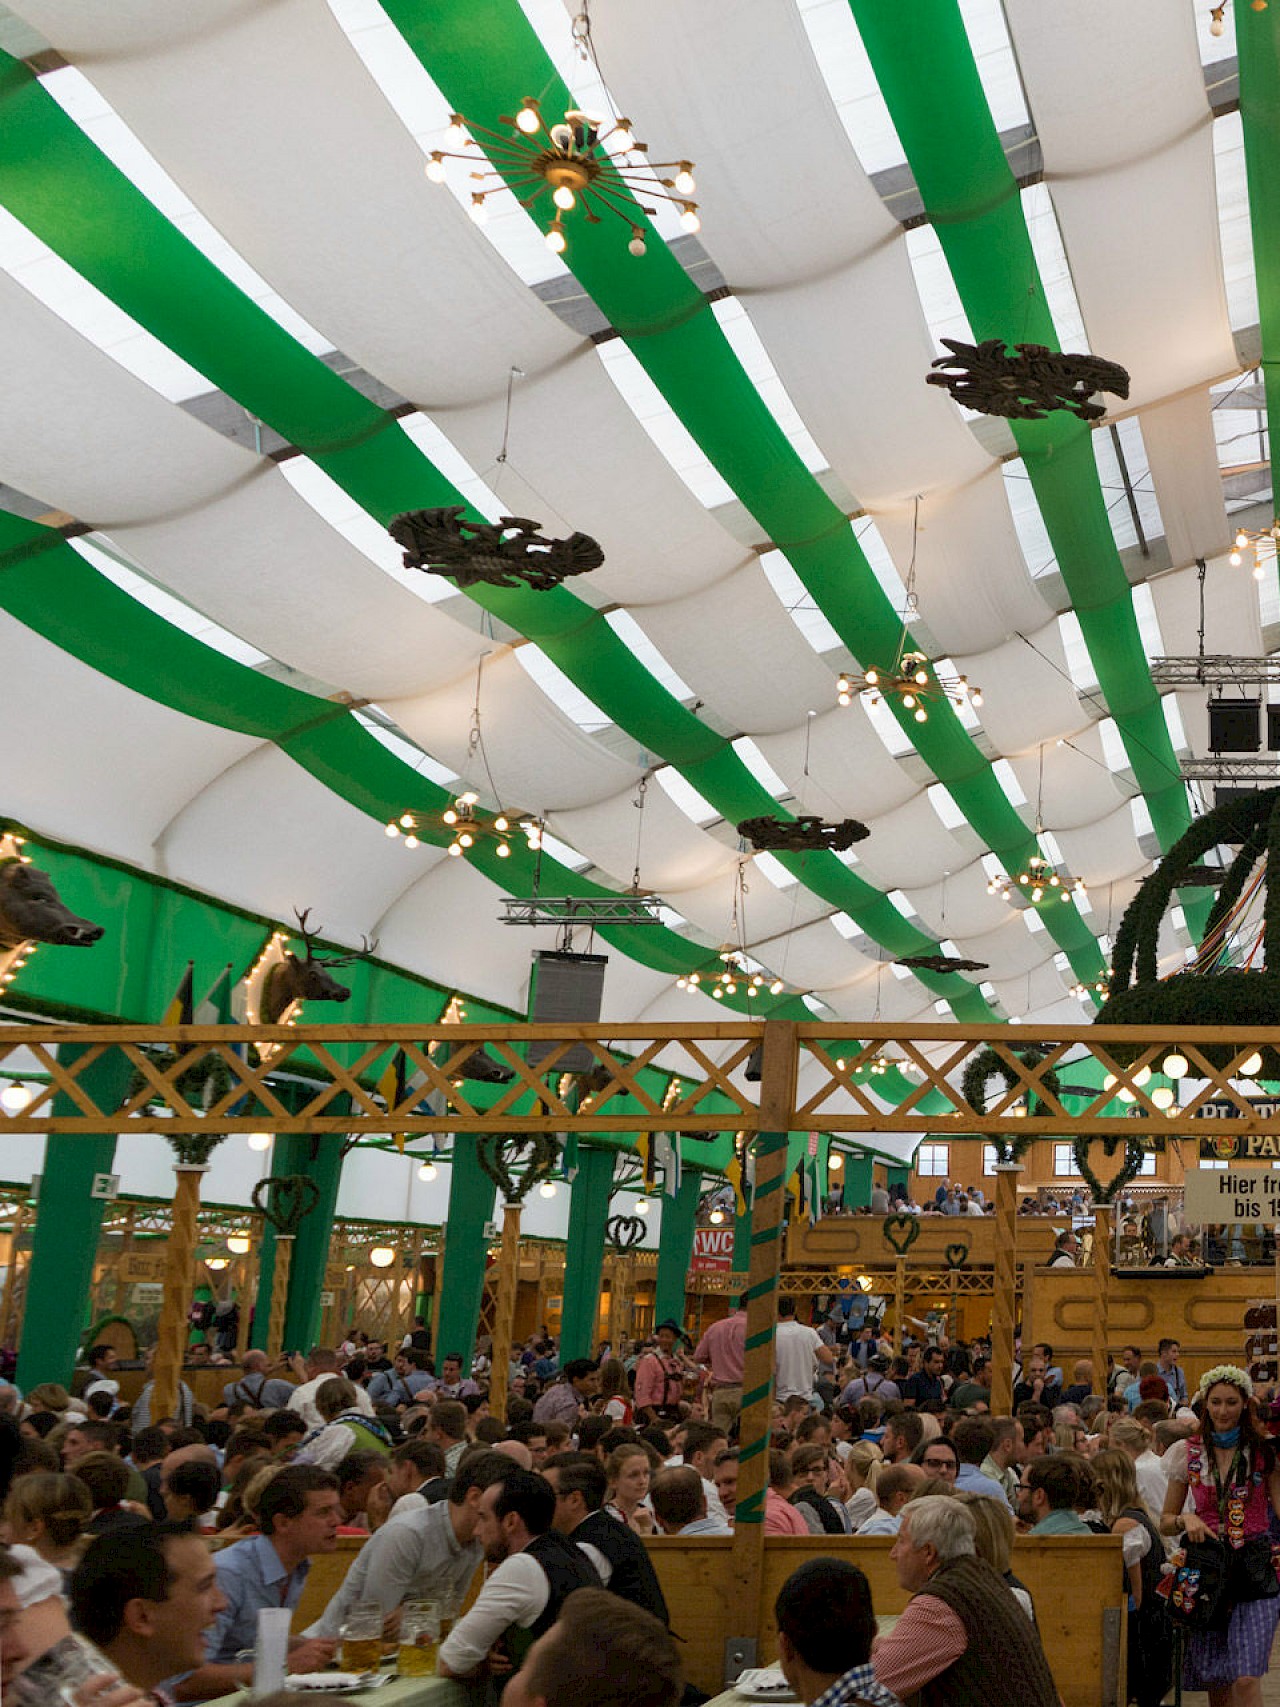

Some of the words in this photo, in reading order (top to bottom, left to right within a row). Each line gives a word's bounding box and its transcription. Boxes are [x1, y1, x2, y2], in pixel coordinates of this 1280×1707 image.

[1219, 1174, 1257, 1194] Hier
[1234, 1198, 1261, 1217] bis
[700, 1231, 734, 1253] WC
